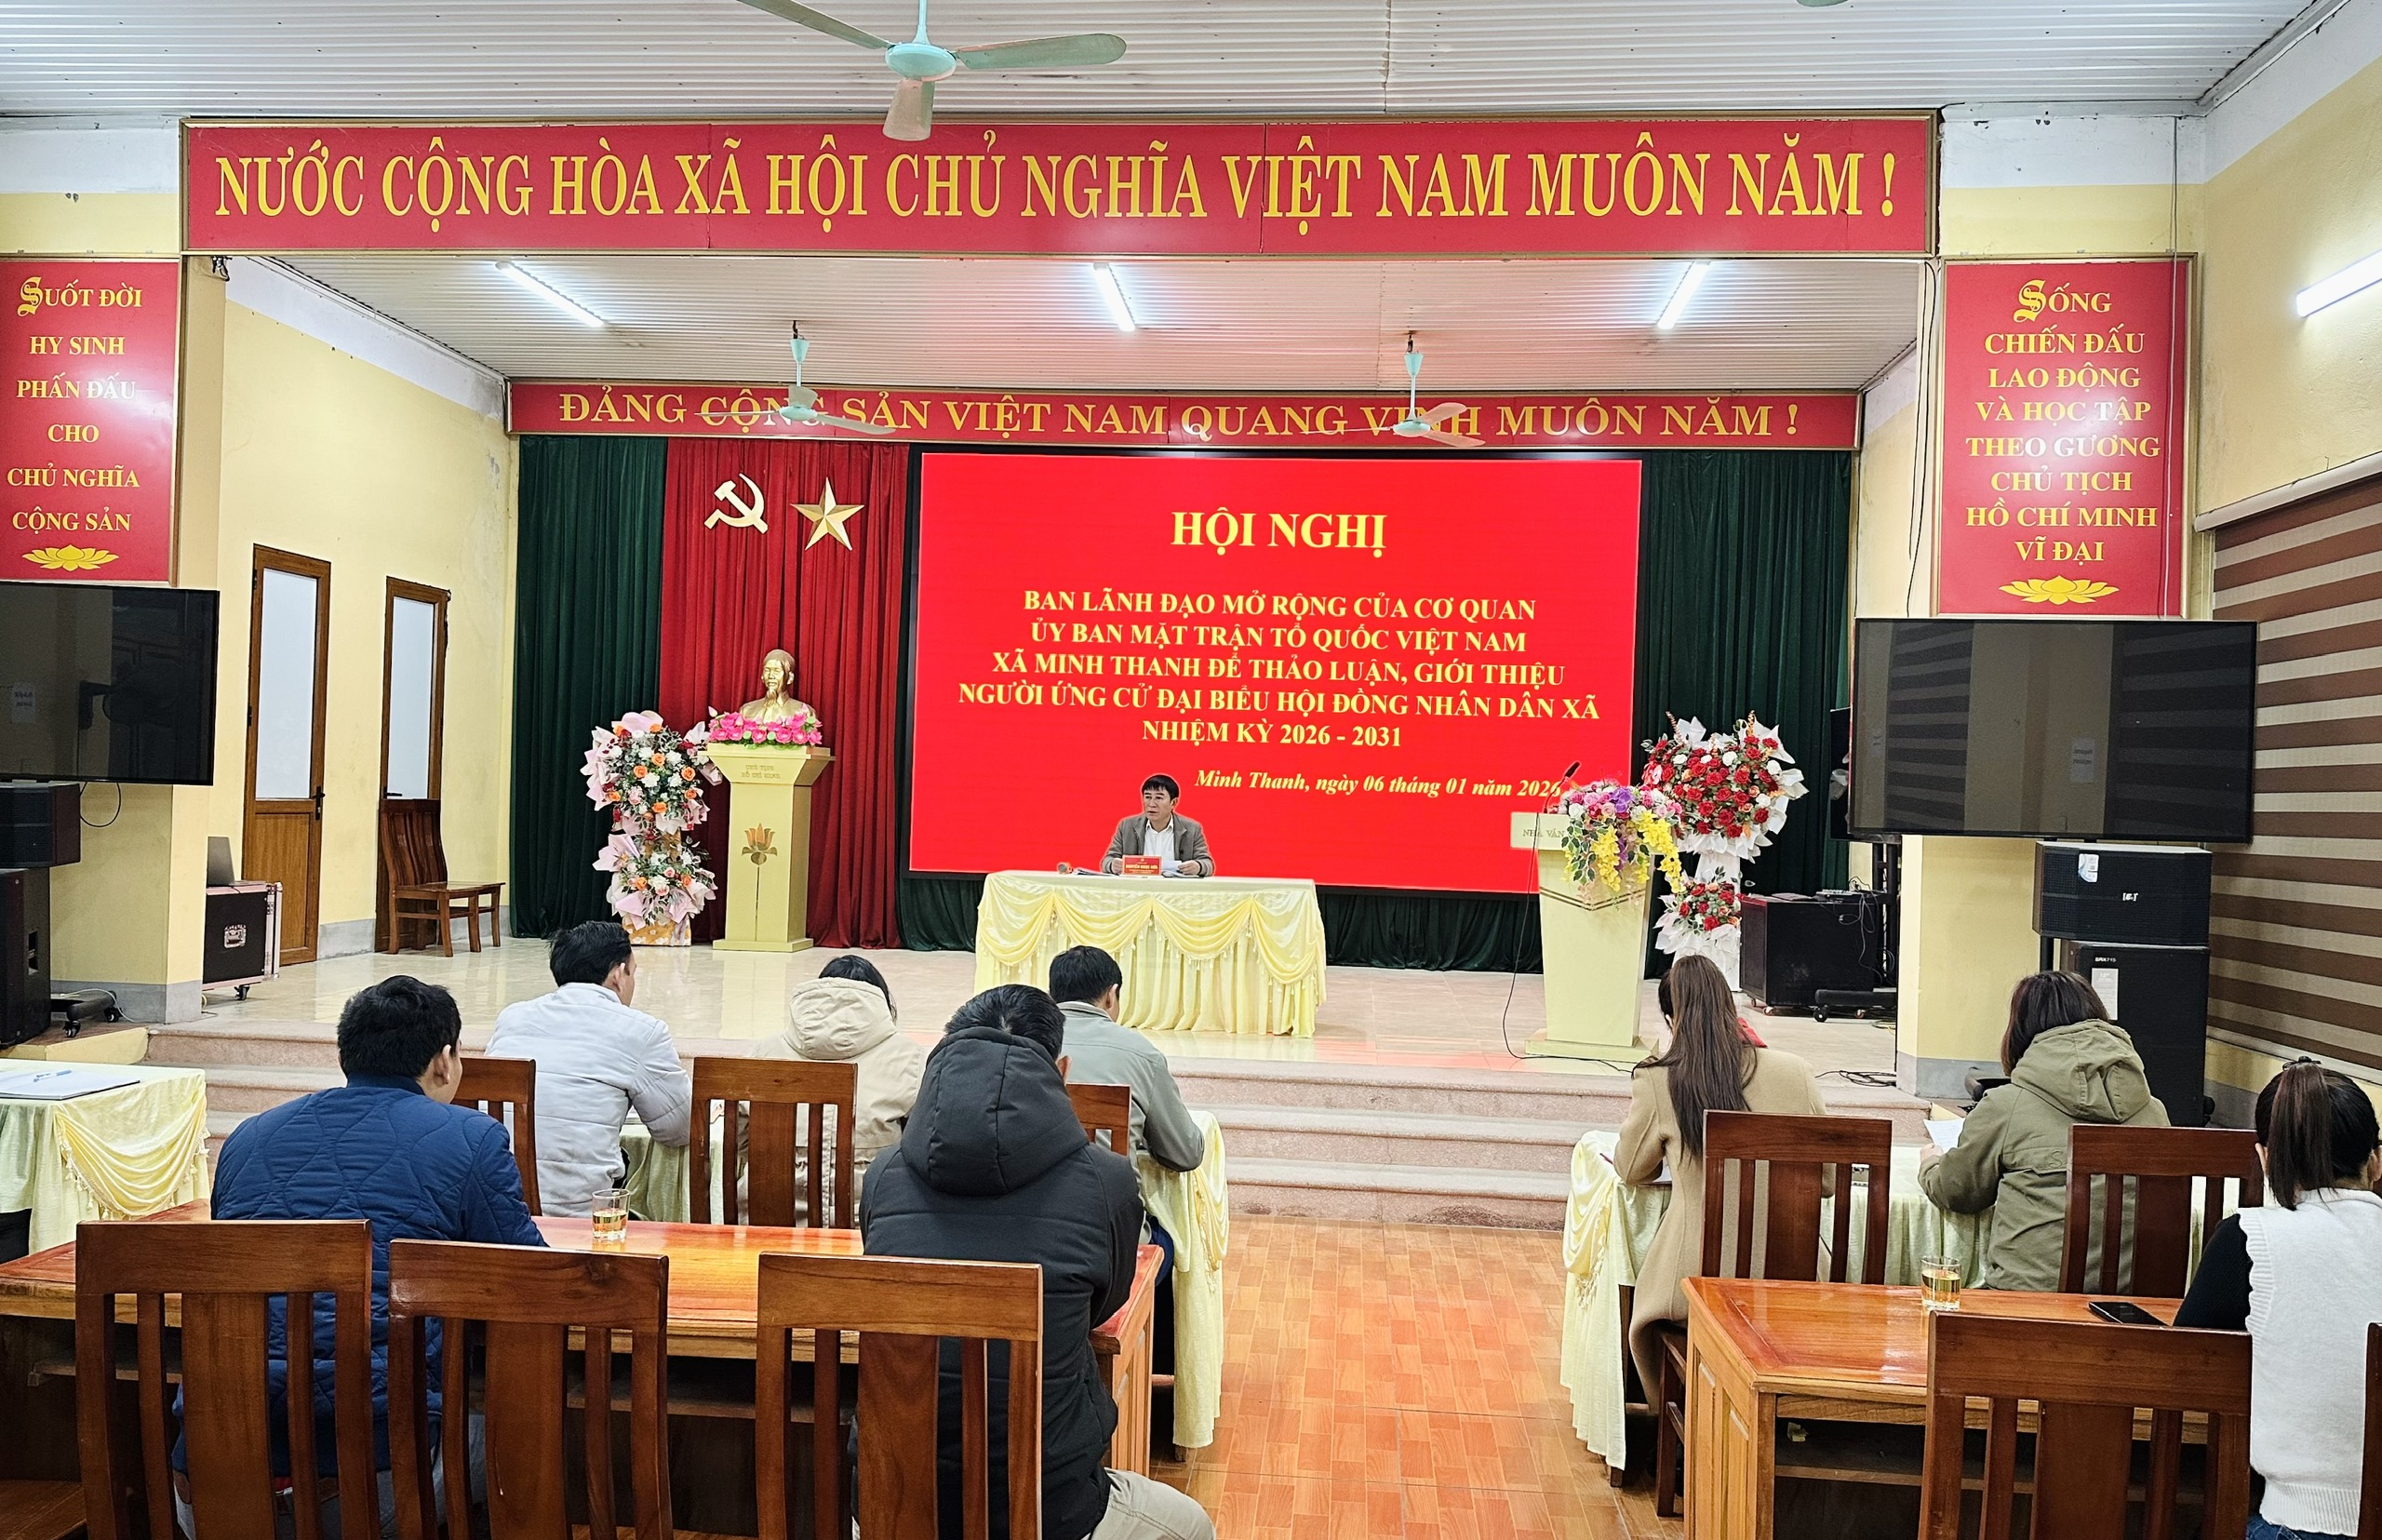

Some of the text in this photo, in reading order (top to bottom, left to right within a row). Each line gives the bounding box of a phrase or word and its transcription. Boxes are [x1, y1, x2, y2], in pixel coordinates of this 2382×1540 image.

[215, 129, 1895, 236] NƯỚC CỘNG HÒA XÃ HỘI CHỦ NGHĨA VIỆT NAM MUÔN NĂM !
[17, 276, 142, 317] SUỐT ĐỜI
[2013, 279, 2112, 323] SỐNG
[29, 336, 126, 355] HY SINH
[1985, 323, 2145, 355] CHIẾN ĐẤU
[16, 371, 137, 399] PHẤN ĐẤU
[1988, 362, 2141, 393] LAO ĐỘNG
[559, 385, 686, 423] ĐẢNG
[841, 391, 931, 430] SẢN
[943, 395, 1053, 439] VIỆT
[1062, 404, 1168, 435] NAM
[1181, 405, 1348, 442] QUANG
[1496, 397, 1645, 435] MUÔN
[1661, 395, 1773, 436] NĂM
[1786, 404, 1798, 435] !
[1974, 395, 2151, 426] VÀ HỌC TẬP
[47, 423, 100, 443] CHO
[1965, 436, 2161, 458] THEO GƯƠNG
[7, 462, 141, 488] CHỦ NGHĨA
[1990, 465, 2133, 496] CHỦ TỊCH
[12, 505, 132, 535] CỘNG SẢN
[1966, 496, 2158, 527] HỒ CHÍ MINH
[1171, 506, 1387, 558] HỘI NGHỊ
[2014, 535, 2105, 566] VĨ ĐẠI
[1024, 587, 1536, 623] BAN LÃNH ĐẠO MỞ RỘNG CỦA CƠ QUAN
[1031, 617, 1526, 656] ỦY BAN MẶT TRẬN TỔ QUỐC VIỆT NAM
[992, 648, 1564, 690] XÃ MINH THANH ĐỂ THẢO LUẬN, GIỚI THIỆU
[958, 679, 1600, 719] NGƯỜI ỨNG CỬ ĐẠI BIỂU HỘI ĐỒNG NHÂN DÂN XÃ
[1143, 718, 1229, 746] NHIỆM
[1237, 717, 1274, 743] KỲ
[1279, 724, 1331, 745] 2026
[1351, 726, 1400, 747] 2031
[1194, 770, 1562, 798] Minh Thanh, ngày 06 tháng 01 năm 2026
